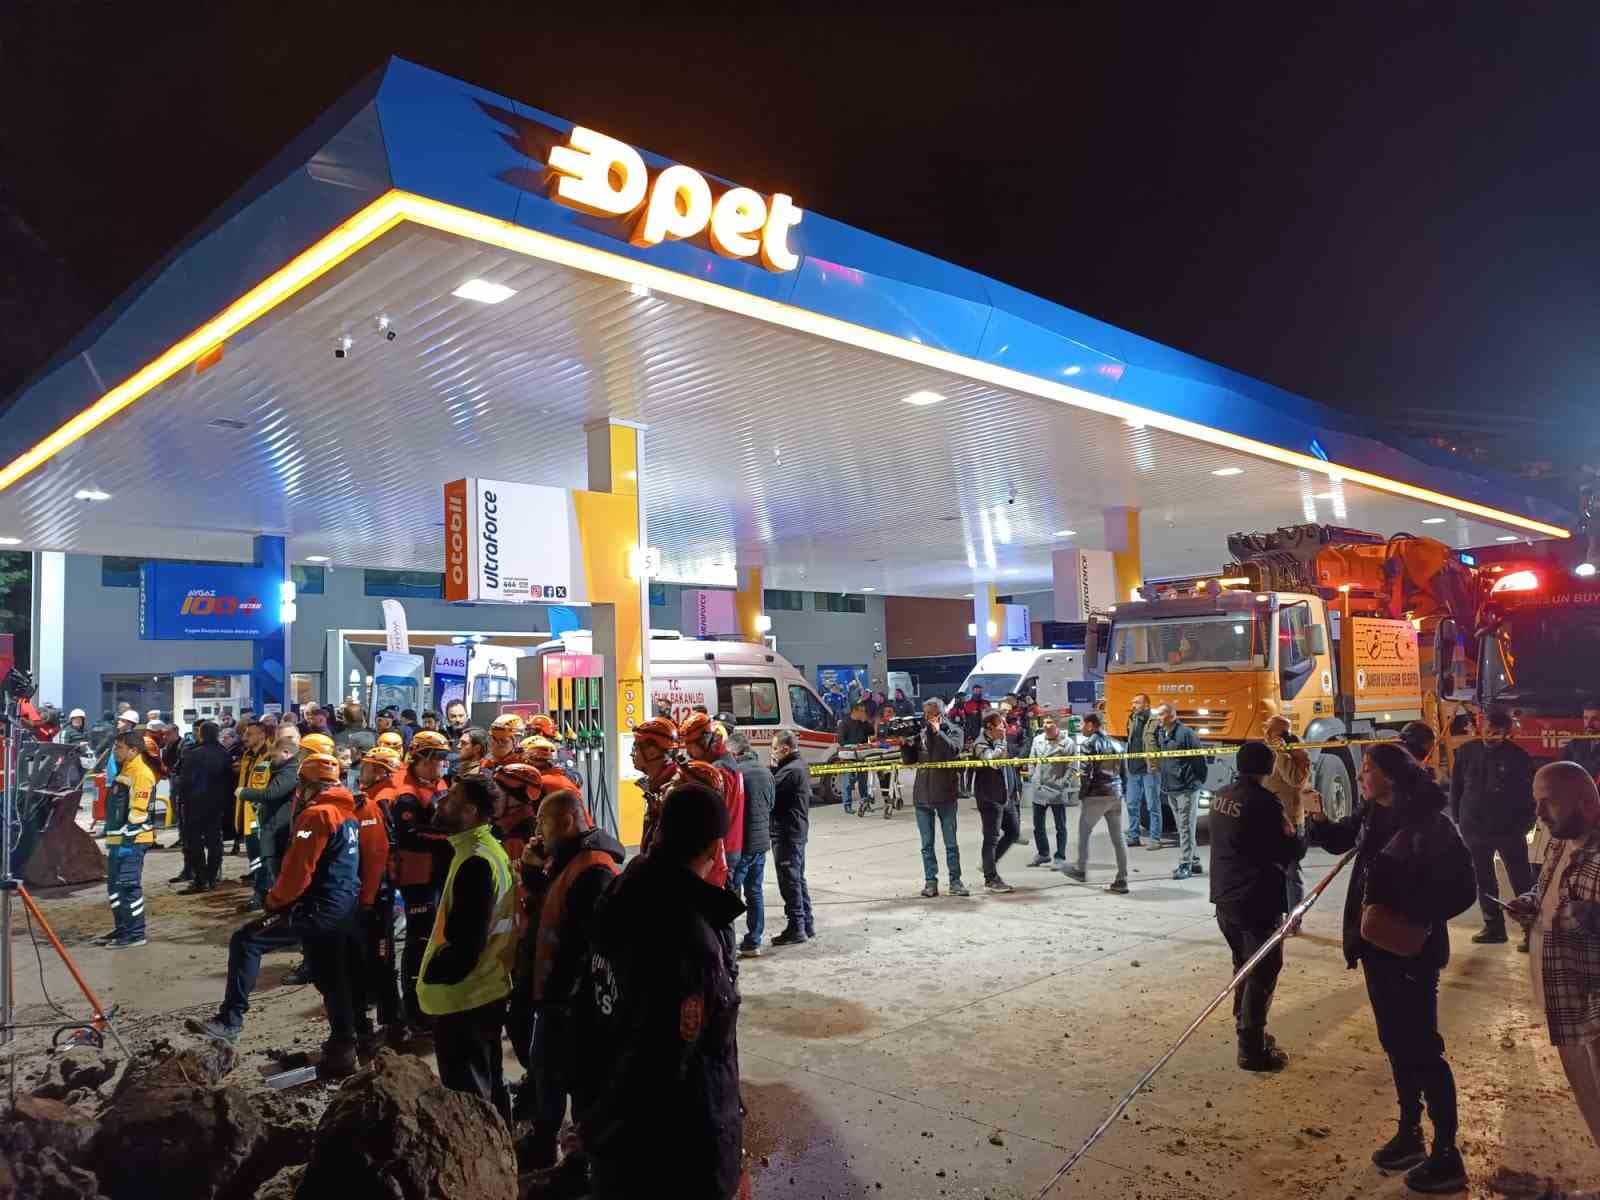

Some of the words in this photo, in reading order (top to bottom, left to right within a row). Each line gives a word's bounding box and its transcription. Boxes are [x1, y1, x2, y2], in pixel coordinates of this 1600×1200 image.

[449, 496, 463, 584] otobil
[484, 491, 499, 589] ultraforce
[1158, 684, 1194, 693] IVECO
